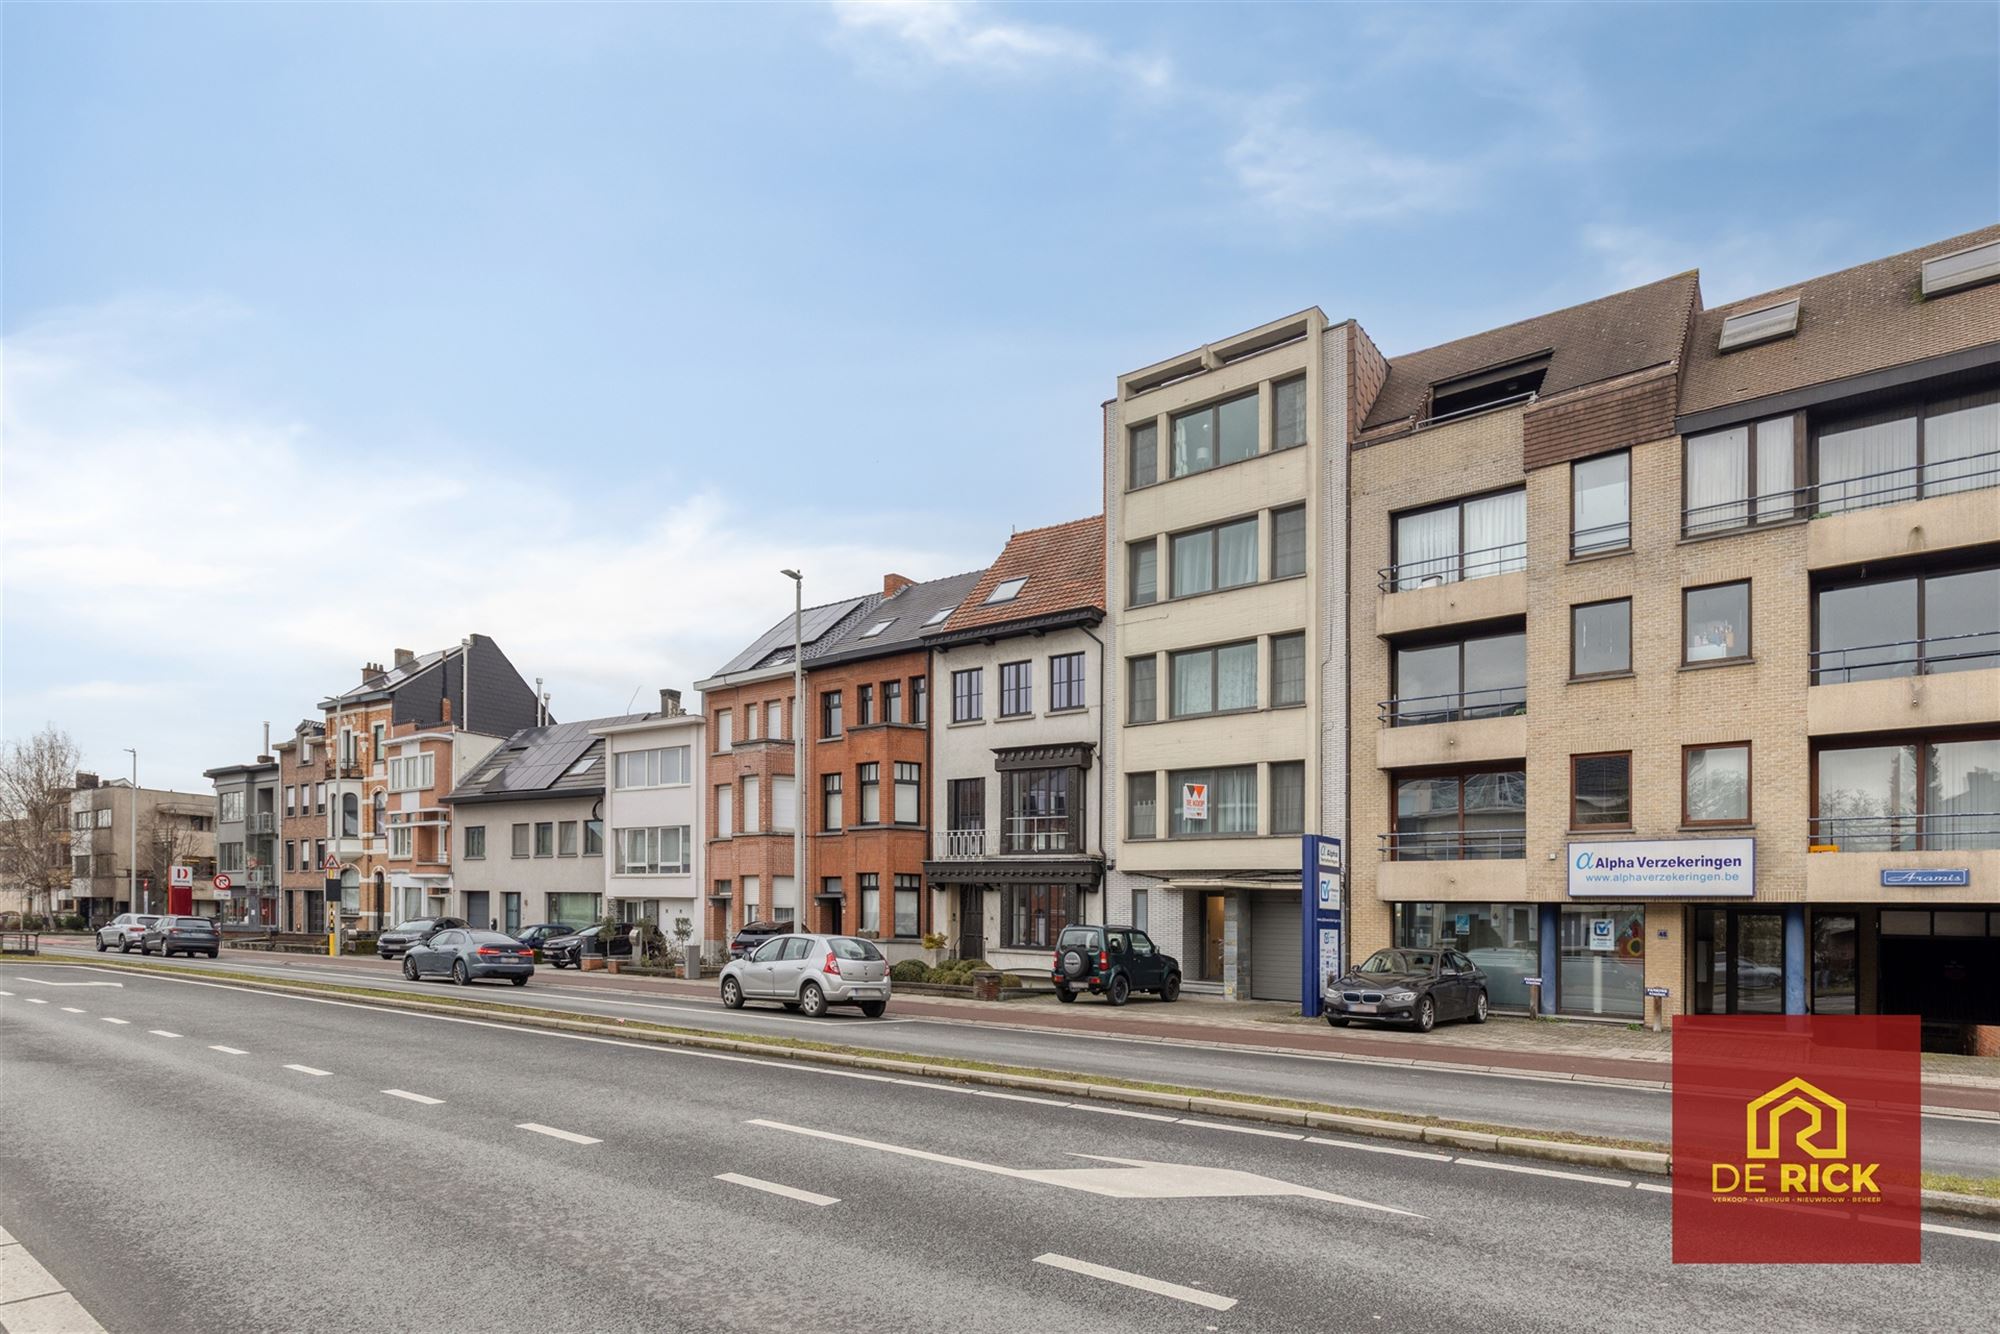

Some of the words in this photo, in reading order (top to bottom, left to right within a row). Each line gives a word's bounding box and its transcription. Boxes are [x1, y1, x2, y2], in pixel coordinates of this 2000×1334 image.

[1595, 857, 1634, 871] Alpha
[1636, 855, 1742, 870] Verzekeringen
[1585, 872, 1739, 883] www.alphaverzekeringen.be
[1887, 871, 1962, 882] Aramis
